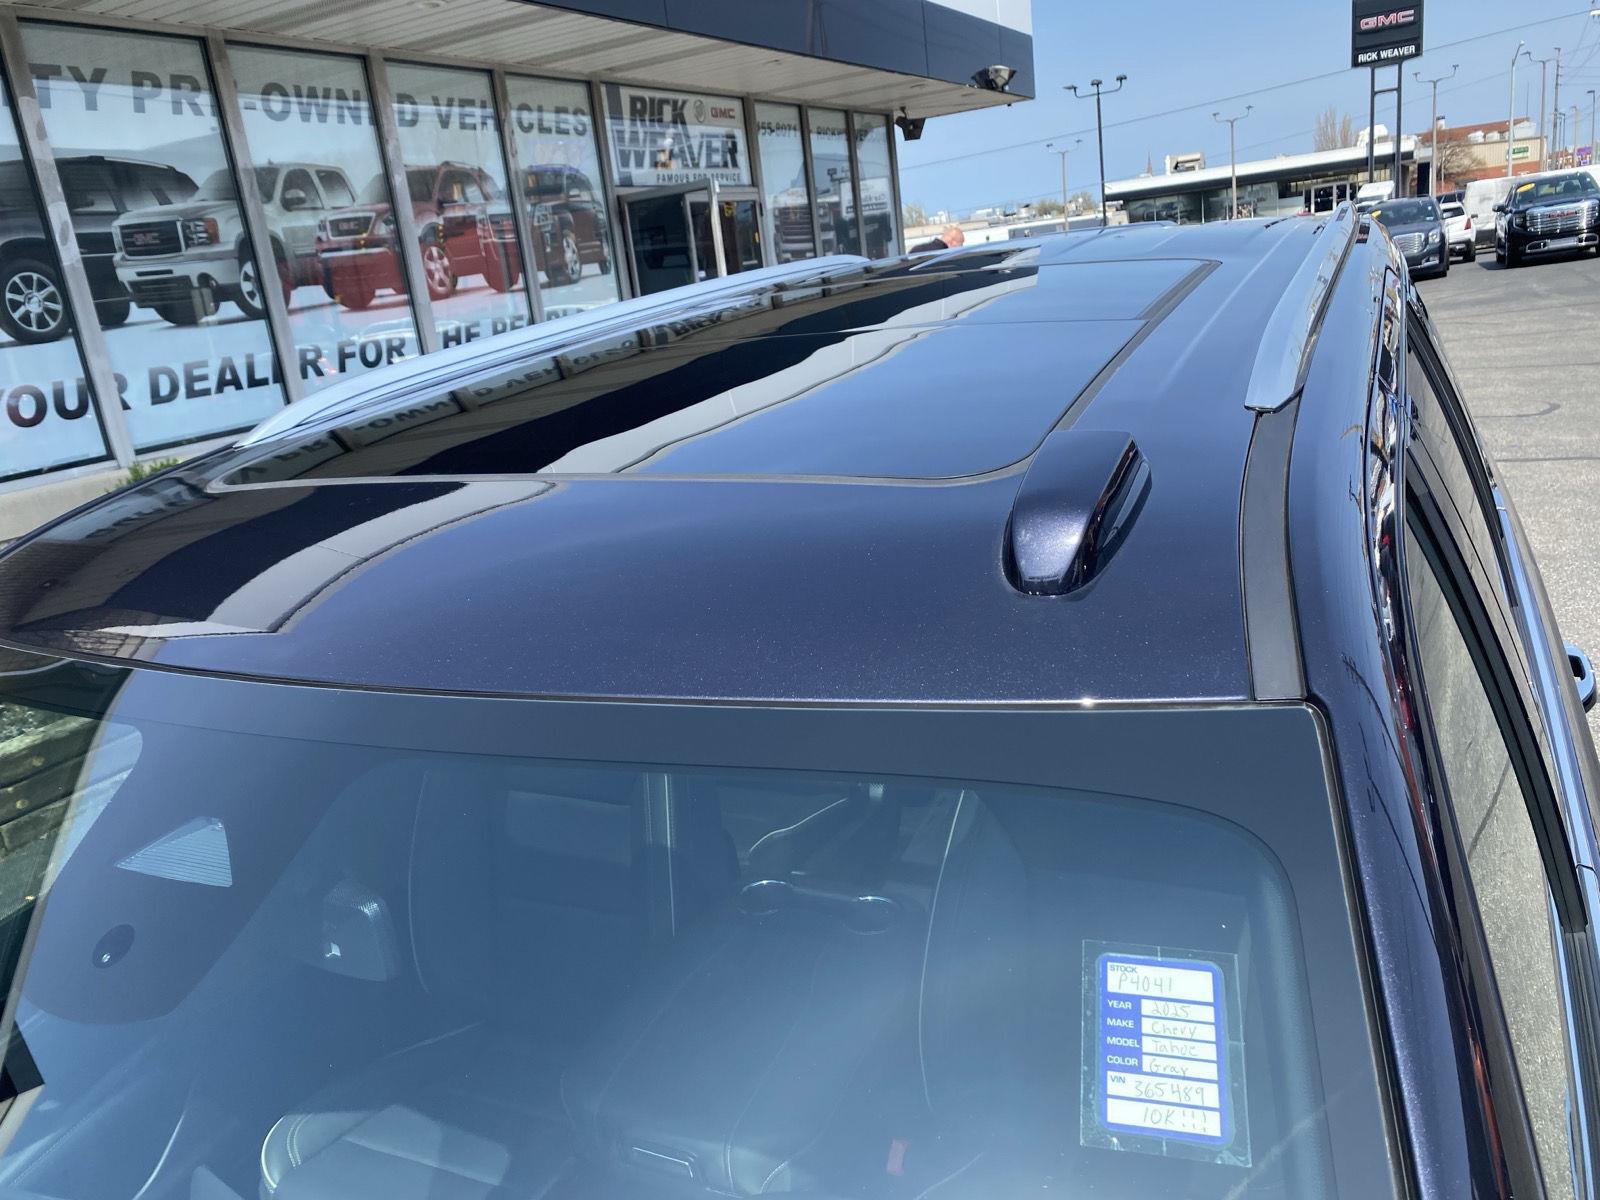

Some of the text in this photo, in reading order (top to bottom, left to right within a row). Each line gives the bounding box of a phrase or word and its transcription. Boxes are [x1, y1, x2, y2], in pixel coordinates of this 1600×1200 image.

[1360, 9, 1414, 30] GMC
[1358, 45, 1415, 63] RICK WEAVER
[1, 63, 588, 137] TY PR-OWND VEHCLES
[629, 94, 688, 129] RICK
[711, 107, 735, 119] GMC
[615, 130, 739, 168] WEAVER
[656, 172, 690, 183] FAMOUS
[0, 372, 132, 428] OUR
[149, 342, 325, 406] DEALR
[338, 336, 406, 374] FOR
[442, 320, 481, 350] HE
[1109, 964, 1138, 974] STOCK
[1118, 973, 1173, 991] P4041
[1107, 999, 1132, 1010] YEAR
[1151, 1003, 1191, 1018] 2025
[1106, 1017, 1135, 1029] MAKE
[1151, 1021, 1197, 1039] Chevy
[1106, 1036, 1140, 1048] MODEL
[1151, 1039, 1199, 1057] Tahoe
[1106, 1055, 1139, 1067] COLOR
[1148, 1057, 1189, 1077] Gray
[1110, 1075, 1126, 1084] VIN
